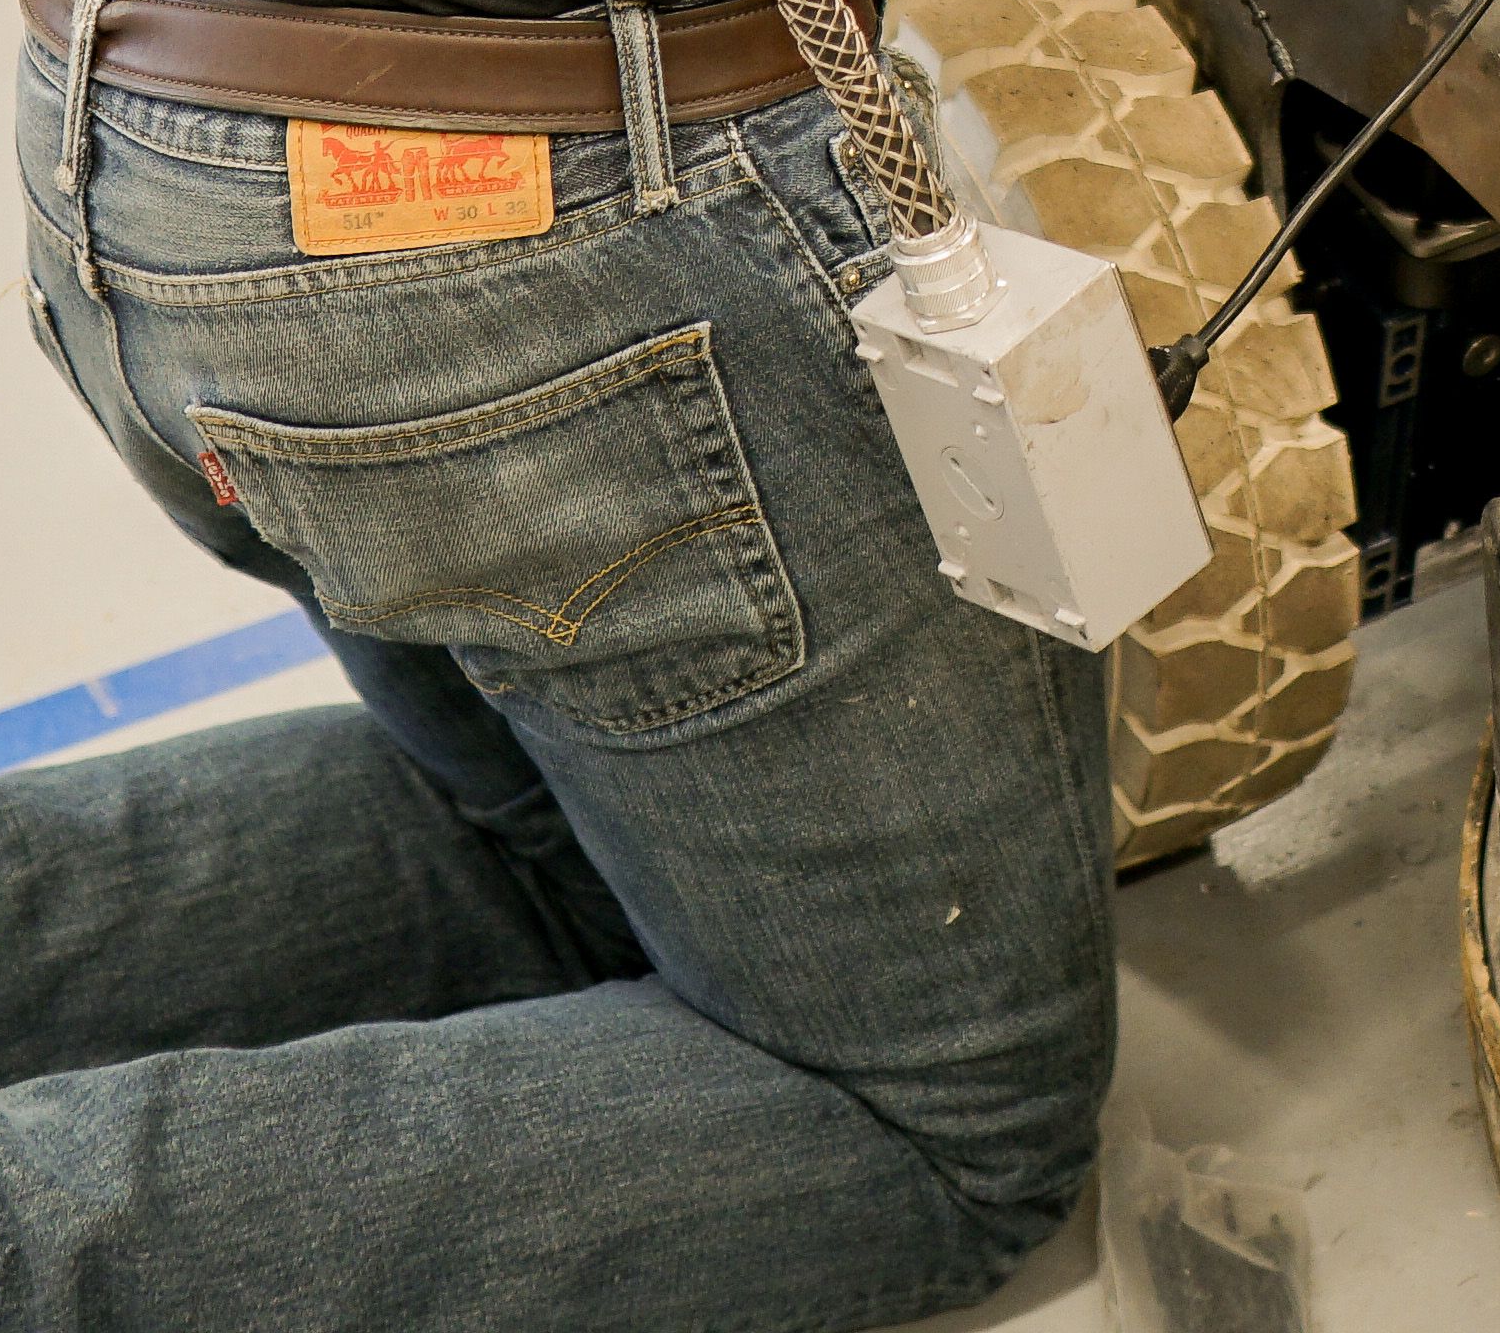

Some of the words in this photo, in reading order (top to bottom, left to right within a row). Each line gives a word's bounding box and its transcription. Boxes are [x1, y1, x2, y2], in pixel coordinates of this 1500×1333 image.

[433, 206, 449, 221] W
[455, 205, 478, 221] 30
[487, 201, 498, 216] L
[504, 200, 528, 215] 32
